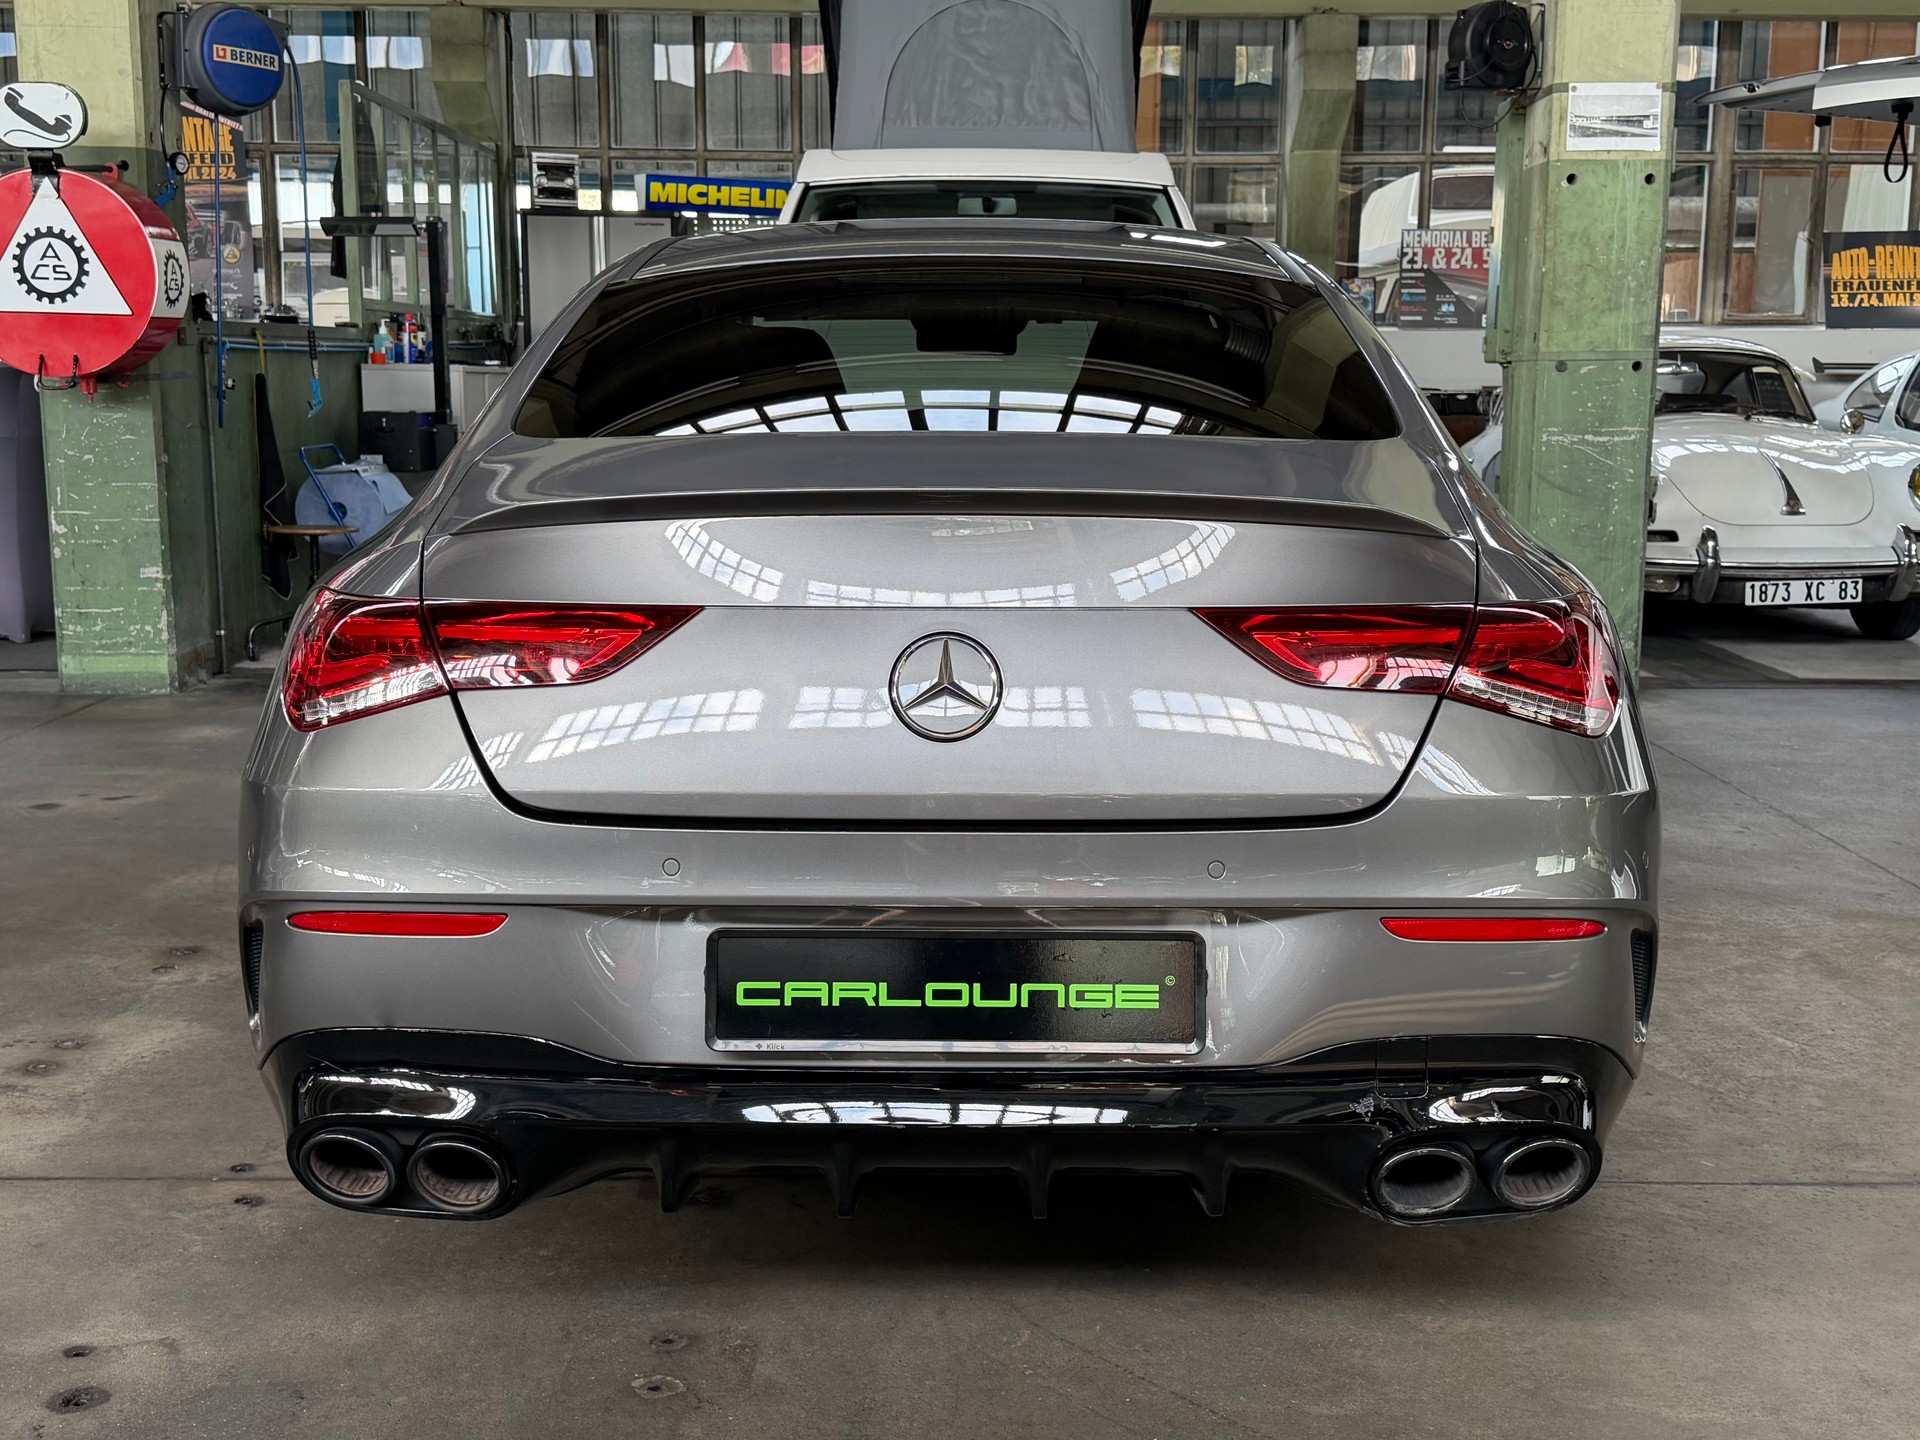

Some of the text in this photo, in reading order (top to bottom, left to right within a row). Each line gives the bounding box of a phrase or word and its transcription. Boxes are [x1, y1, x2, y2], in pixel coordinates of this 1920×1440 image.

[230, 49, 276, 69] BERNER
[182, 115, 234, 152] NTAGE
[1402, 230, 1489, 248] MEMORIAL BE
[39, 241, 63, 262] A
[1402, 247, 1491, 269] 23. & 24. S
[1831, 245, 1920, 280] AUTO-RENNT
[30, 264, 72, 281] CS
[1749, 580, 1859, 603] 1873 XC 83
[736, 981, 1160, 1009] CARLOUNGE
